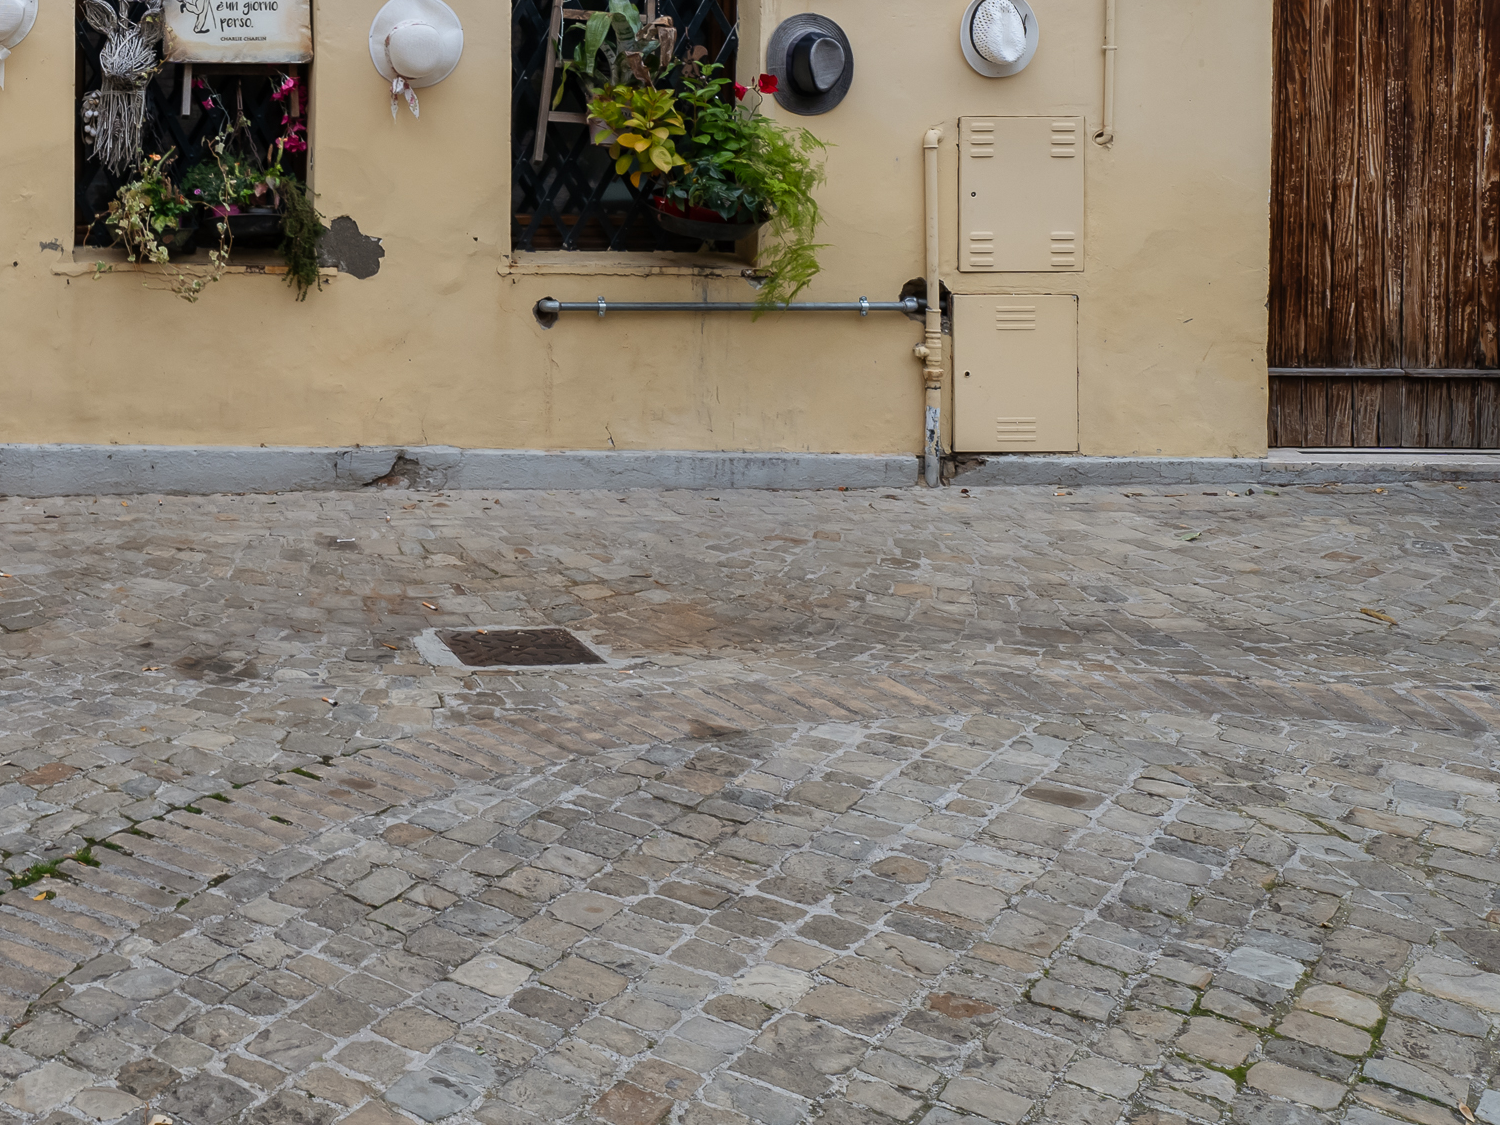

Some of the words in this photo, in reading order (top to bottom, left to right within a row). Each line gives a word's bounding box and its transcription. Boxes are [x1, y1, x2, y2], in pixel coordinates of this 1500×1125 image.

[225, 1, 239, 11] un
[242, 1, 279, 15] giorno
[220, 17, 254, 32] perso.
